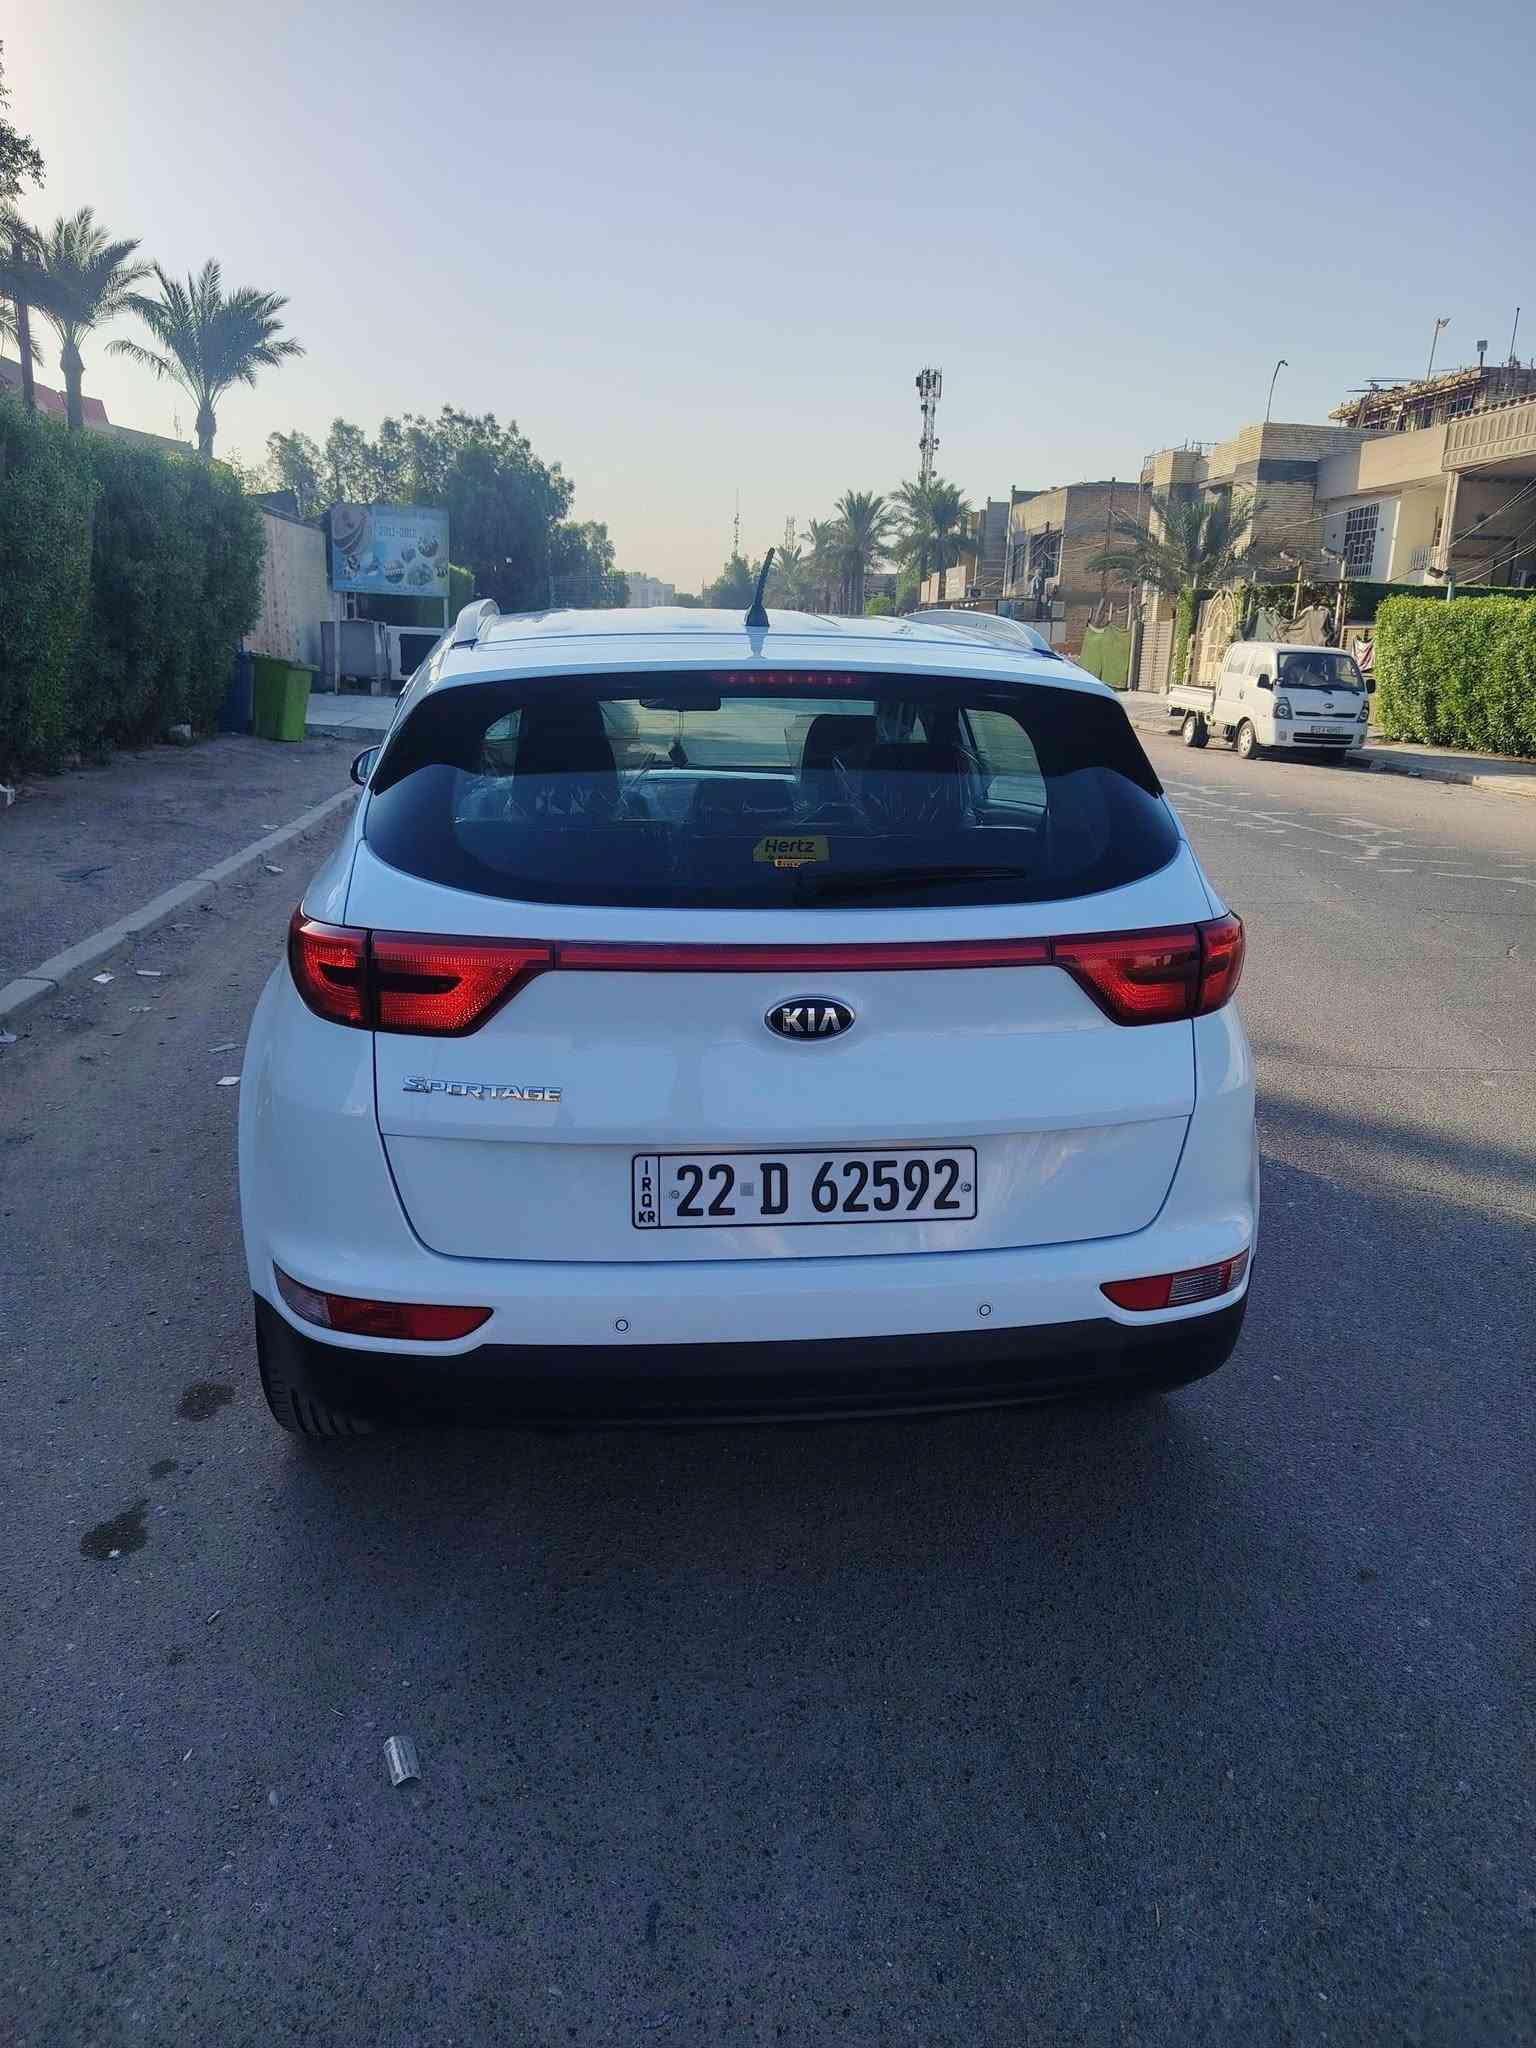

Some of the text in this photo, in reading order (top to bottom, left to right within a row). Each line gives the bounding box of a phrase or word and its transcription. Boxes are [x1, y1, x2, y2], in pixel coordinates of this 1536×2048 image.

[765, 839, 816, 853] Hertz
[782, 1007, 841, 1032] KIA
[402, 1075, 562, 1103] SPORTAGE
[677, 1158, 960, 1217] 22 D 62592
[638, 1210, 656, 1223] KR
